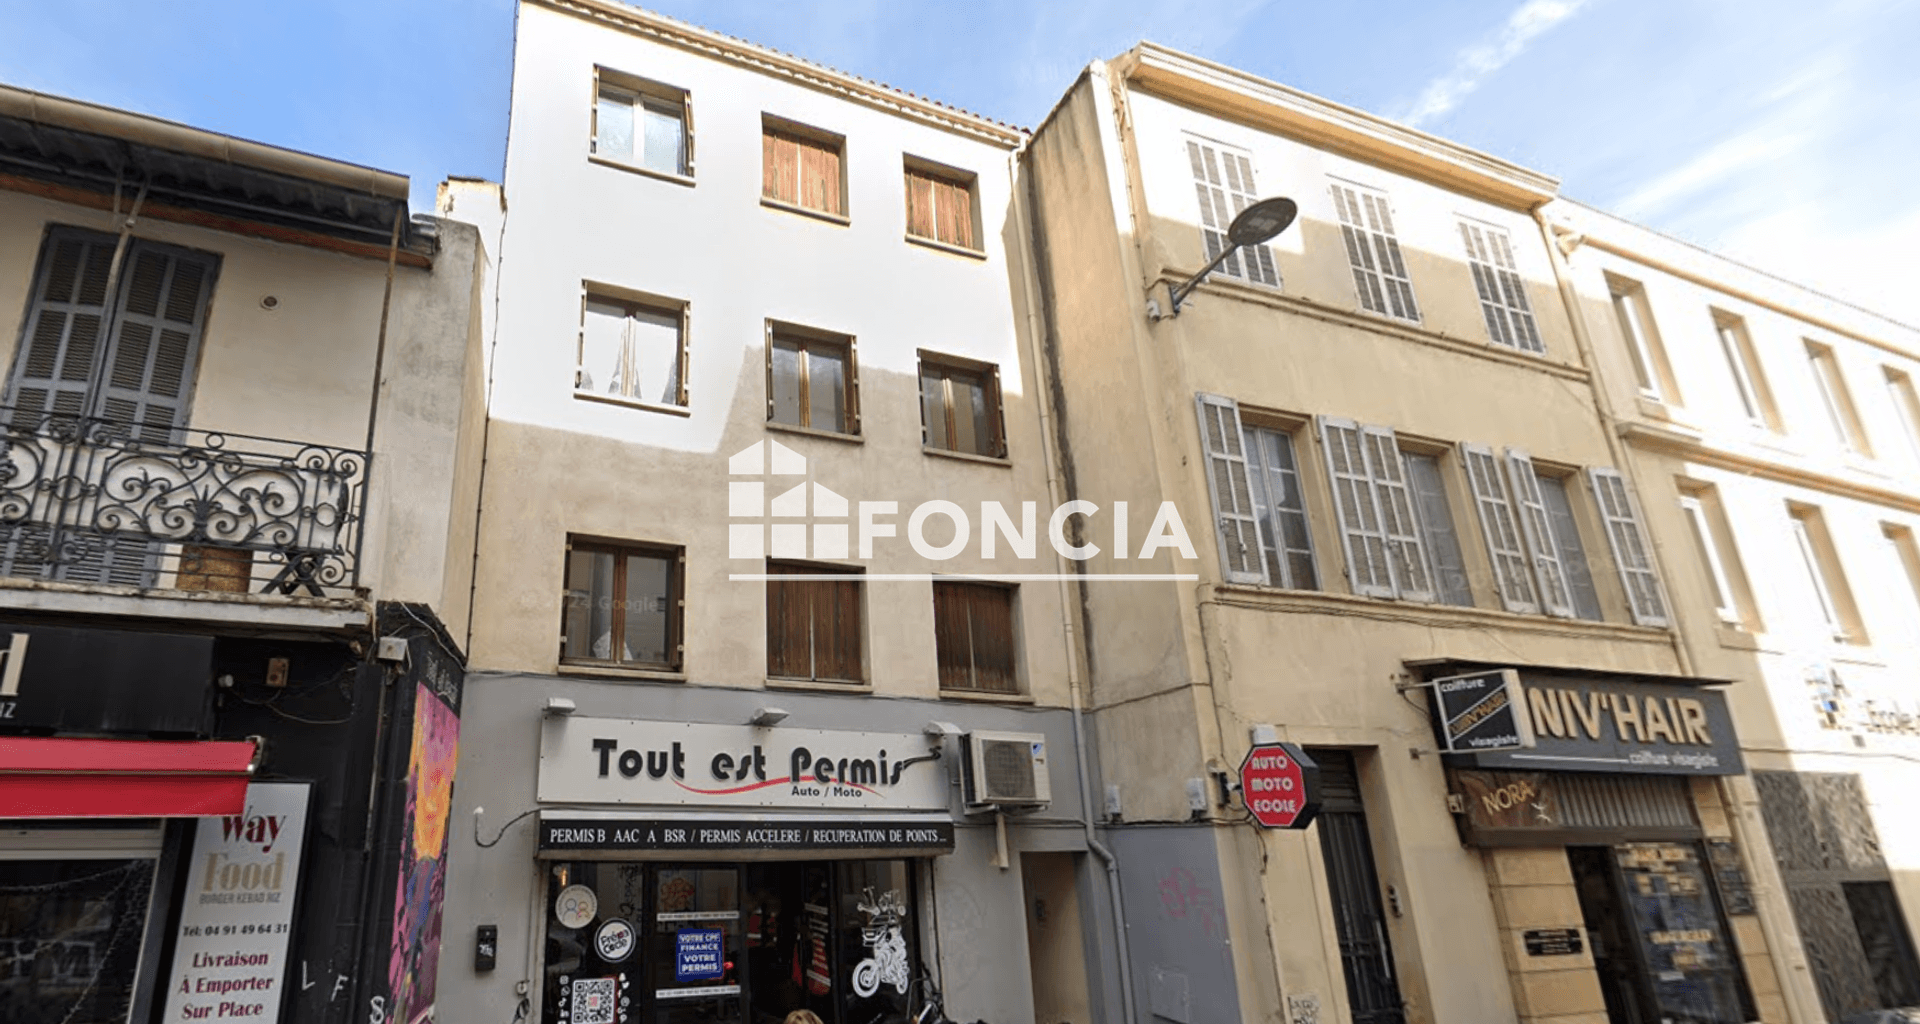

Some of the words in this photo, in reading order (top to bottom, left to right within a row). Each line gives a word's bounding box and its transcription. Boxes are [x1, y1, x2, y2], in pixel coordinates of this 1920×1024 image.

[593, 739, 685, 779] Tout
[711, 745, 766, 781] est
[791, 747, 904, 785] Permis
[1252, 756, 1287, 769] AUTO
[1252, 778, 1294, 791] MOTO
[791, 786, 820, 797] Auto
[833, 787, 862, 797] Moto
[1482, 780, 1535, 815] NORA
[1254, 800, 1296, 812] ECOLE
[550, 829, 595, 843] PERMIS
[597, 829, 606, 843] B
[613, 829, 640, 843] AAC
[647, 829, 656, 843] A
[664, 829, 687, 843] BSR
[700, 829, 741, 843] PERMIS
[745, 829, 801, 843] ACCELERE
[813, 829, 886, 843] RECUPERATION
[889, 830, 902, 842] DE
[203, 852, 285, 891] Food
[681, 943, 719, 952] FINANCE
[192, 951, 269, 968] Livraison
[684, 953, 716, 963] VOTRE
[681, 963, 718, 973] PERMIS
[195, 977, 274, 995] Emporter
[182, 1003, 213, 1020] Sur
[218, 1001, 263, 1018] Place
